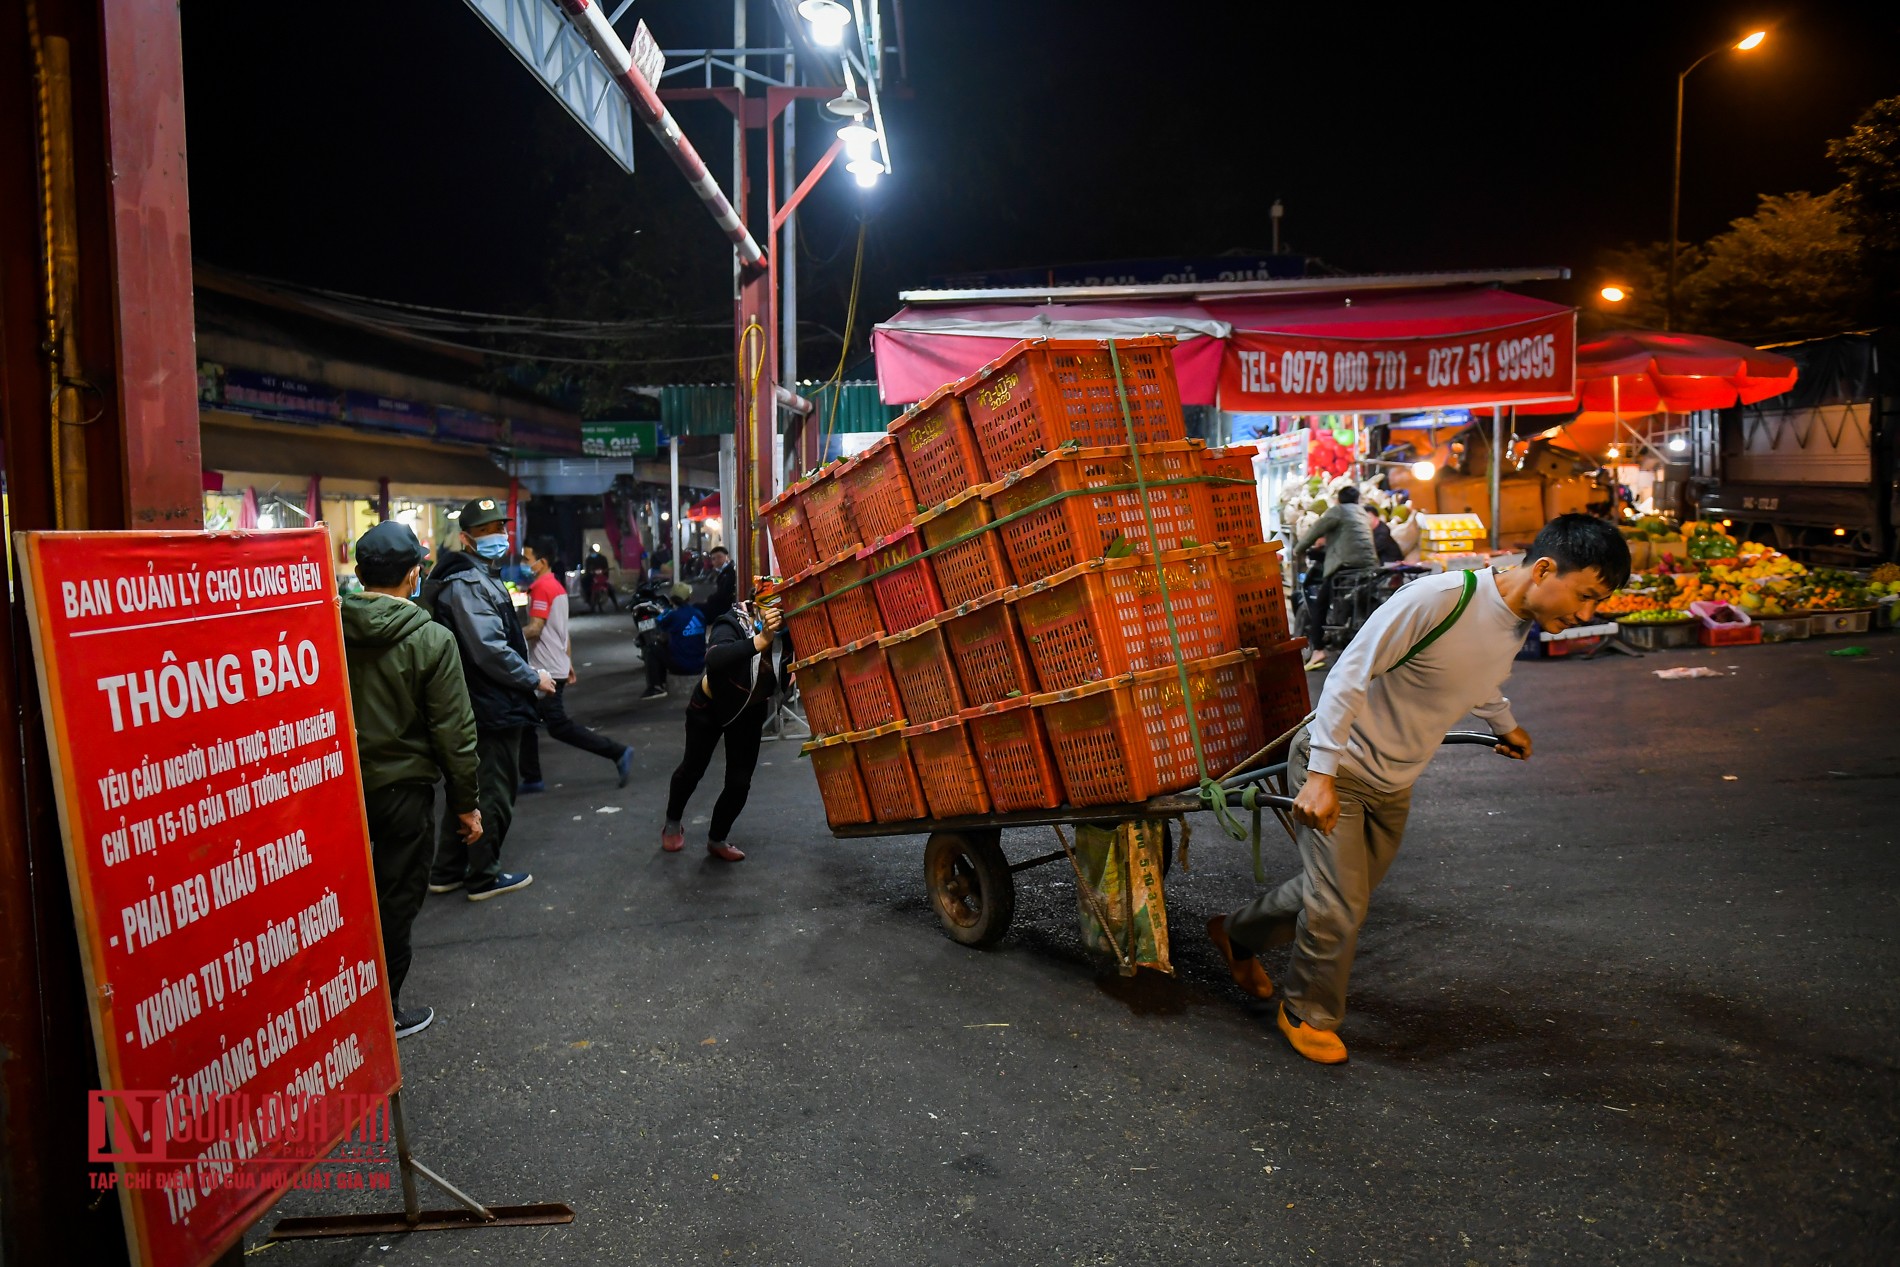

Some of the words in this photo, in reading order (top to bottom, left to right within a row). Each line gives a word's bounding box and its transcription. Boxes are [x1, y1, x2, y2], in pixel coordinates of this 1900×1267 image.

[990, 391, 1011, 411] 2020
[1238, 350, 1276, 393] TEL:
[1281, 350, 1328, 394] 0973
[1333, 351, 1368, 392] 000
[1373, 350, 1407, 390] 701
[1427, 345, 1464, 388] 037
[1468, 341, 1491, 383] 51
[1497, 334, 1555, 381] 99995
[61, 578, 113, 619] BAN
[115, 561, 176, 614] QUẢN
[178, 562, 200, 606] LÝ
[205, 566, 242, 610] CHỢ
[244, 563, 288, 598] LONG
[288, 555, 322, 593] BIÊN
[97, 650, 246, 733] THÔNG
[251, 630, 320, 698] BÁO
[97, 768, 130, 810] YÊU
[131, 754, 163, 801] CẦU
[163, 743, 207, 790] NGƯỜI
[207, 737, 236, 776] DÂN
[236, 730, 268, 767] THỰC
[268, 720, 296, 758] HIỆN
[295, 708, 337, 747] NGHIÊM
[101, 815, 131, 867] CHỈ
[130, 818, 158, 857] THỊ
[157, 803, 197, 845] 15-16
[198, 784, 227, 829] CỦA
[226, 772, 252, 818] THỦ
[251, 768, 290, 809] TƯỚNG
[289, 757, 323, 794] CHÍNH
[323, 740, 344, 782] PHỦ
[121, 875, 172, 955] PHẢI
[171, 873, 210, 930] ĐEO
[209, 838, 257, 910] KHẨU
[257, 829, 313, 886] TRANG.
[135, 977, 201, 1050] KHÔNG
[200, 958, 225, 1012] TỤ
[224, 938, 255, 997] TẬP
[256, 917, 299, 975] ĐÔNG
[298, 886, 344, 950] NGƯỜI.
[187, 1034, 257, 1122] KHOẢNG
[256, 1012, 298, 1069] CÁCH
[296, 979, 322, 1040] TỐI
[319, 955, 358, 1023] THIỂU
[357, 958, 378, 998] 2m
[285, 1067, 326, 1123] CÔNG
[324, 1032, 365, 1092] CỘNG.
